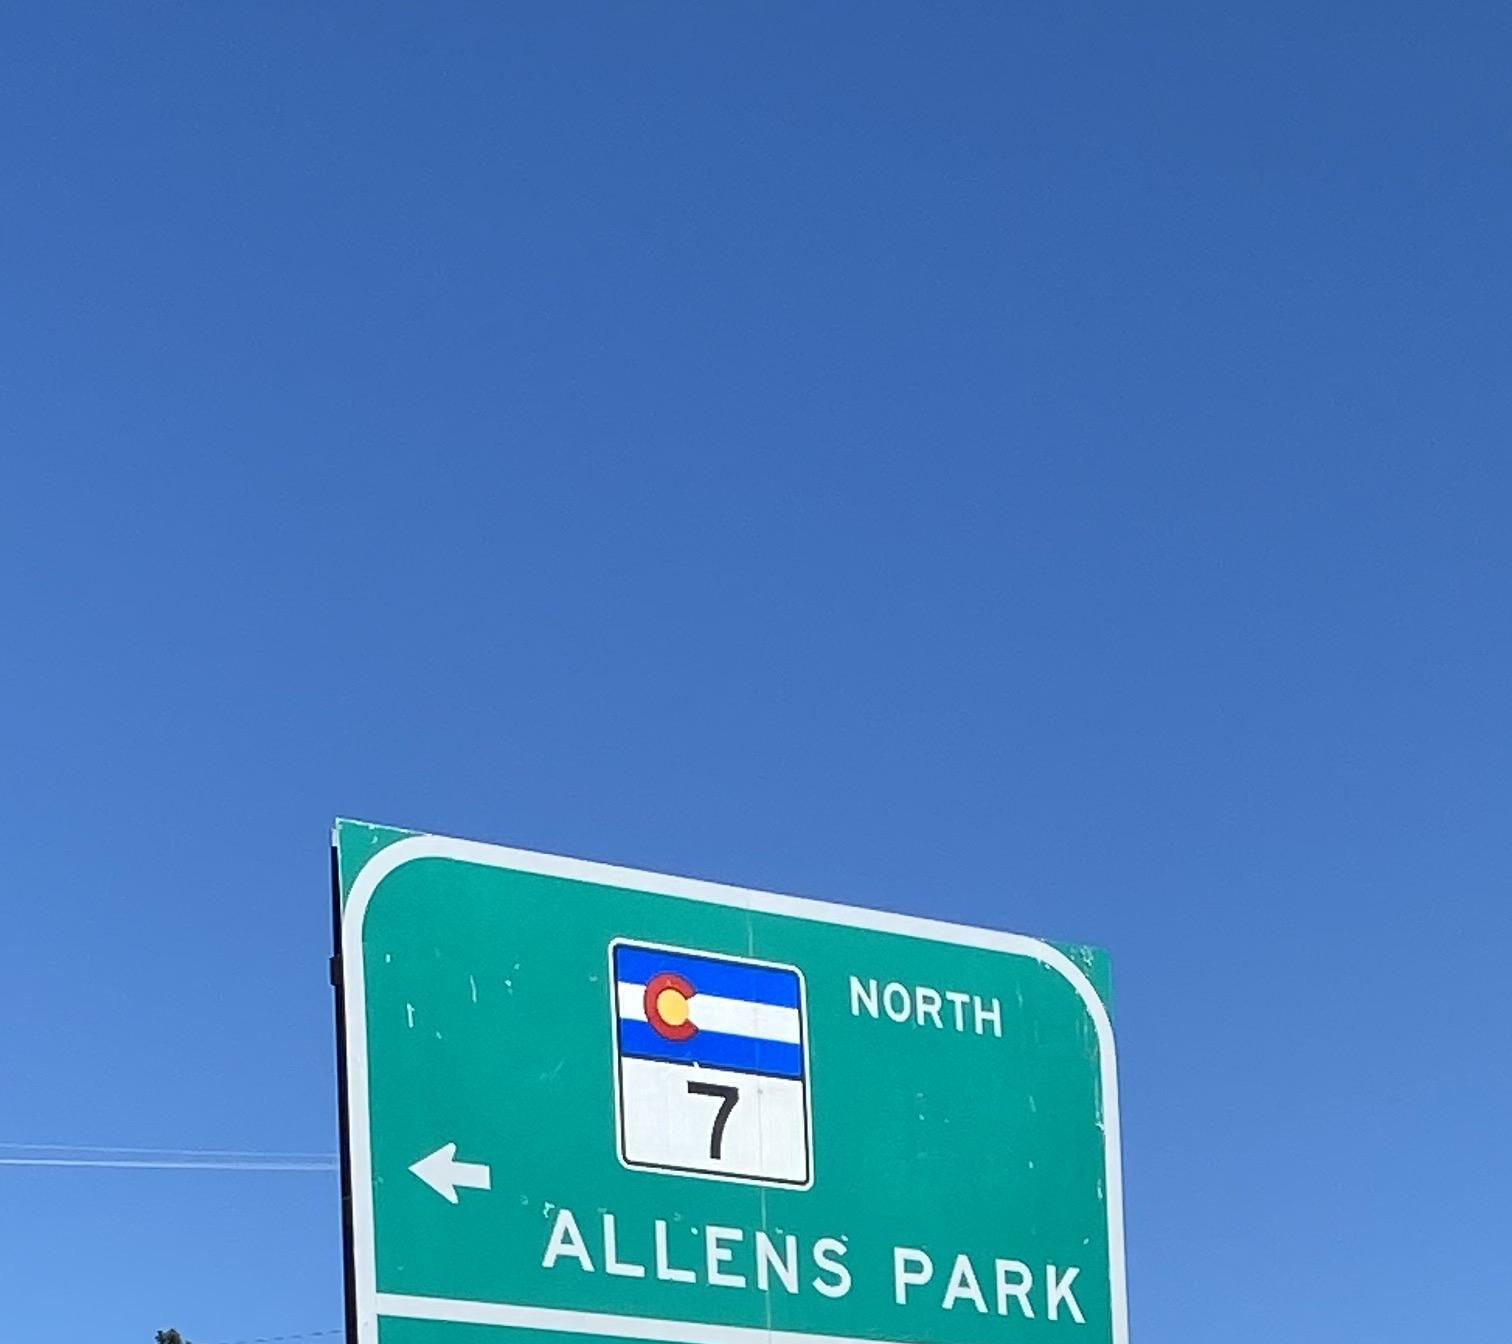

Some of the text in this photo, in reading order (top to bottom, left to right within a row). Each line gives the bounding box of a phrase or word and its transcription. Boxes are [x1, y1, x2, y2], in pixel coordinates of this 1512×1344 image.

[850, 975, 1003, 1036] NORTH
[686, 1080, 739, 1160] 7
[541, 1208, 1086, 1324] ALLENS PARK
